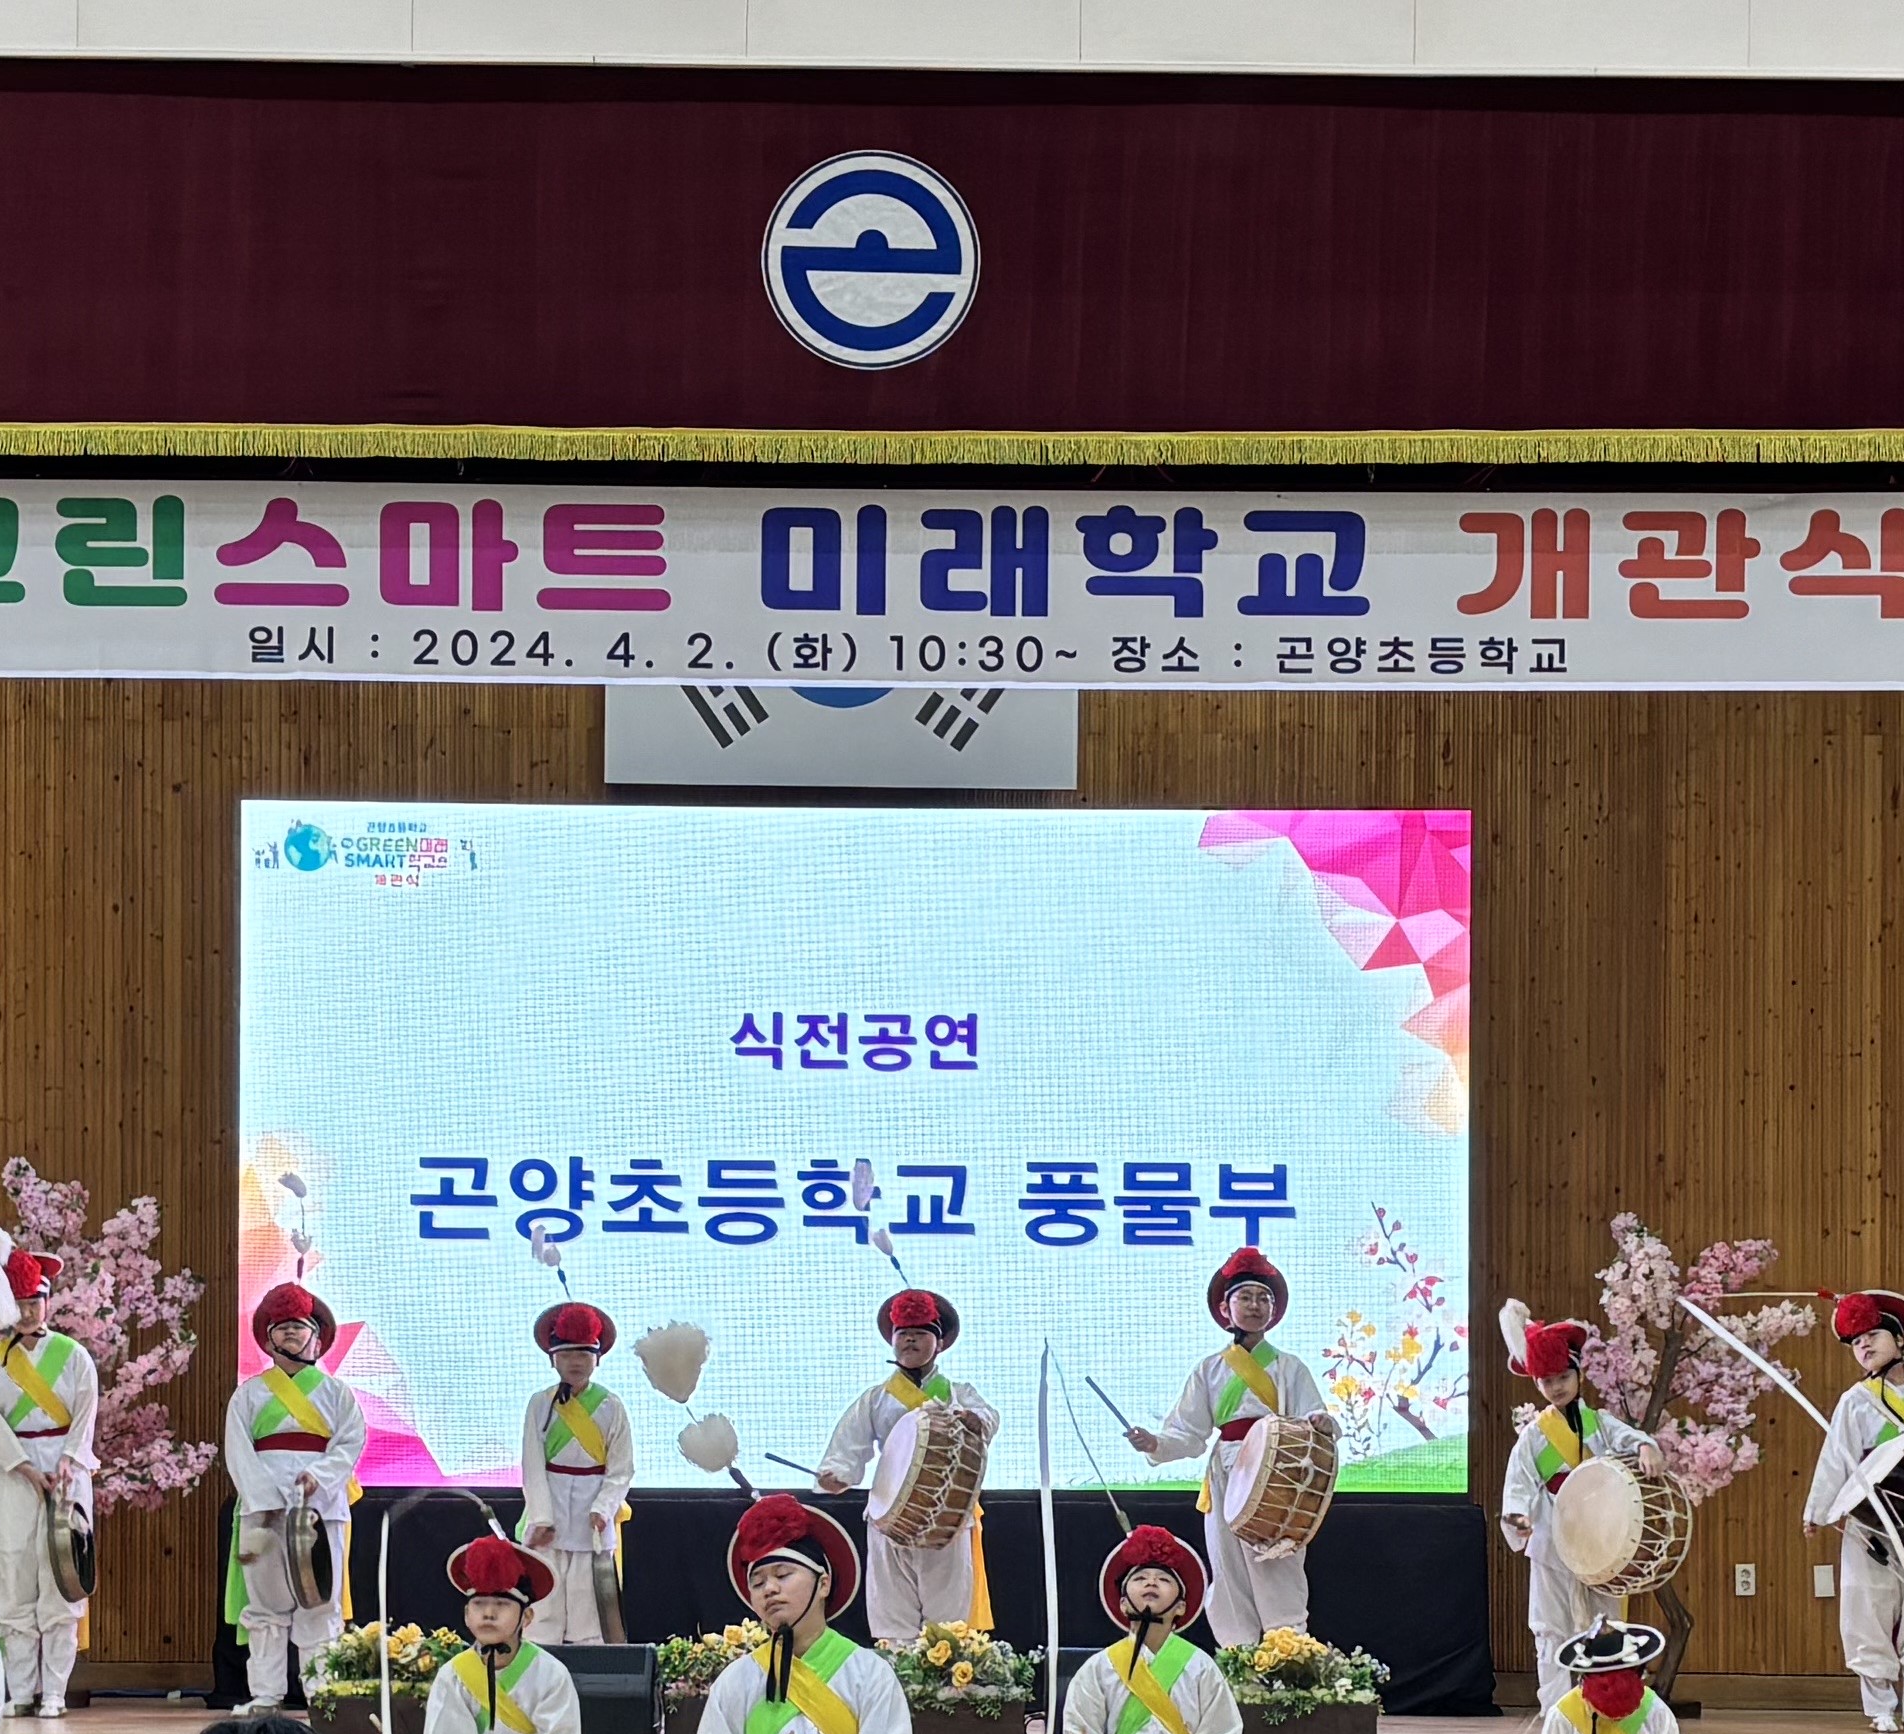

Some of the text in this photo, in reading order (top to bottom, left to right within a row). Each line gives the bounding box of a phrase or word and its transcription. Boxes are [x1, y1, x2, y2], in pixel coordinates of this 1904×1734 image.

[761, 503, 1371, 619] 미래학교
[248, 625, 335, 664] 일시
[411, 628, 574, 668] 2024.
[606, 631, 655, 669] 4.
[686, 632, 735, 670] 2.
[766, 631, 858, 674] (화)
[1110, 635, 1201, 675] 장소
[1275, 636, 1569, 675] 곤양초등학교
[729, 1010, 981, 1072] 식전공연
[409, 1155, 1298, 1247] 곤양초등학교 풍물부
